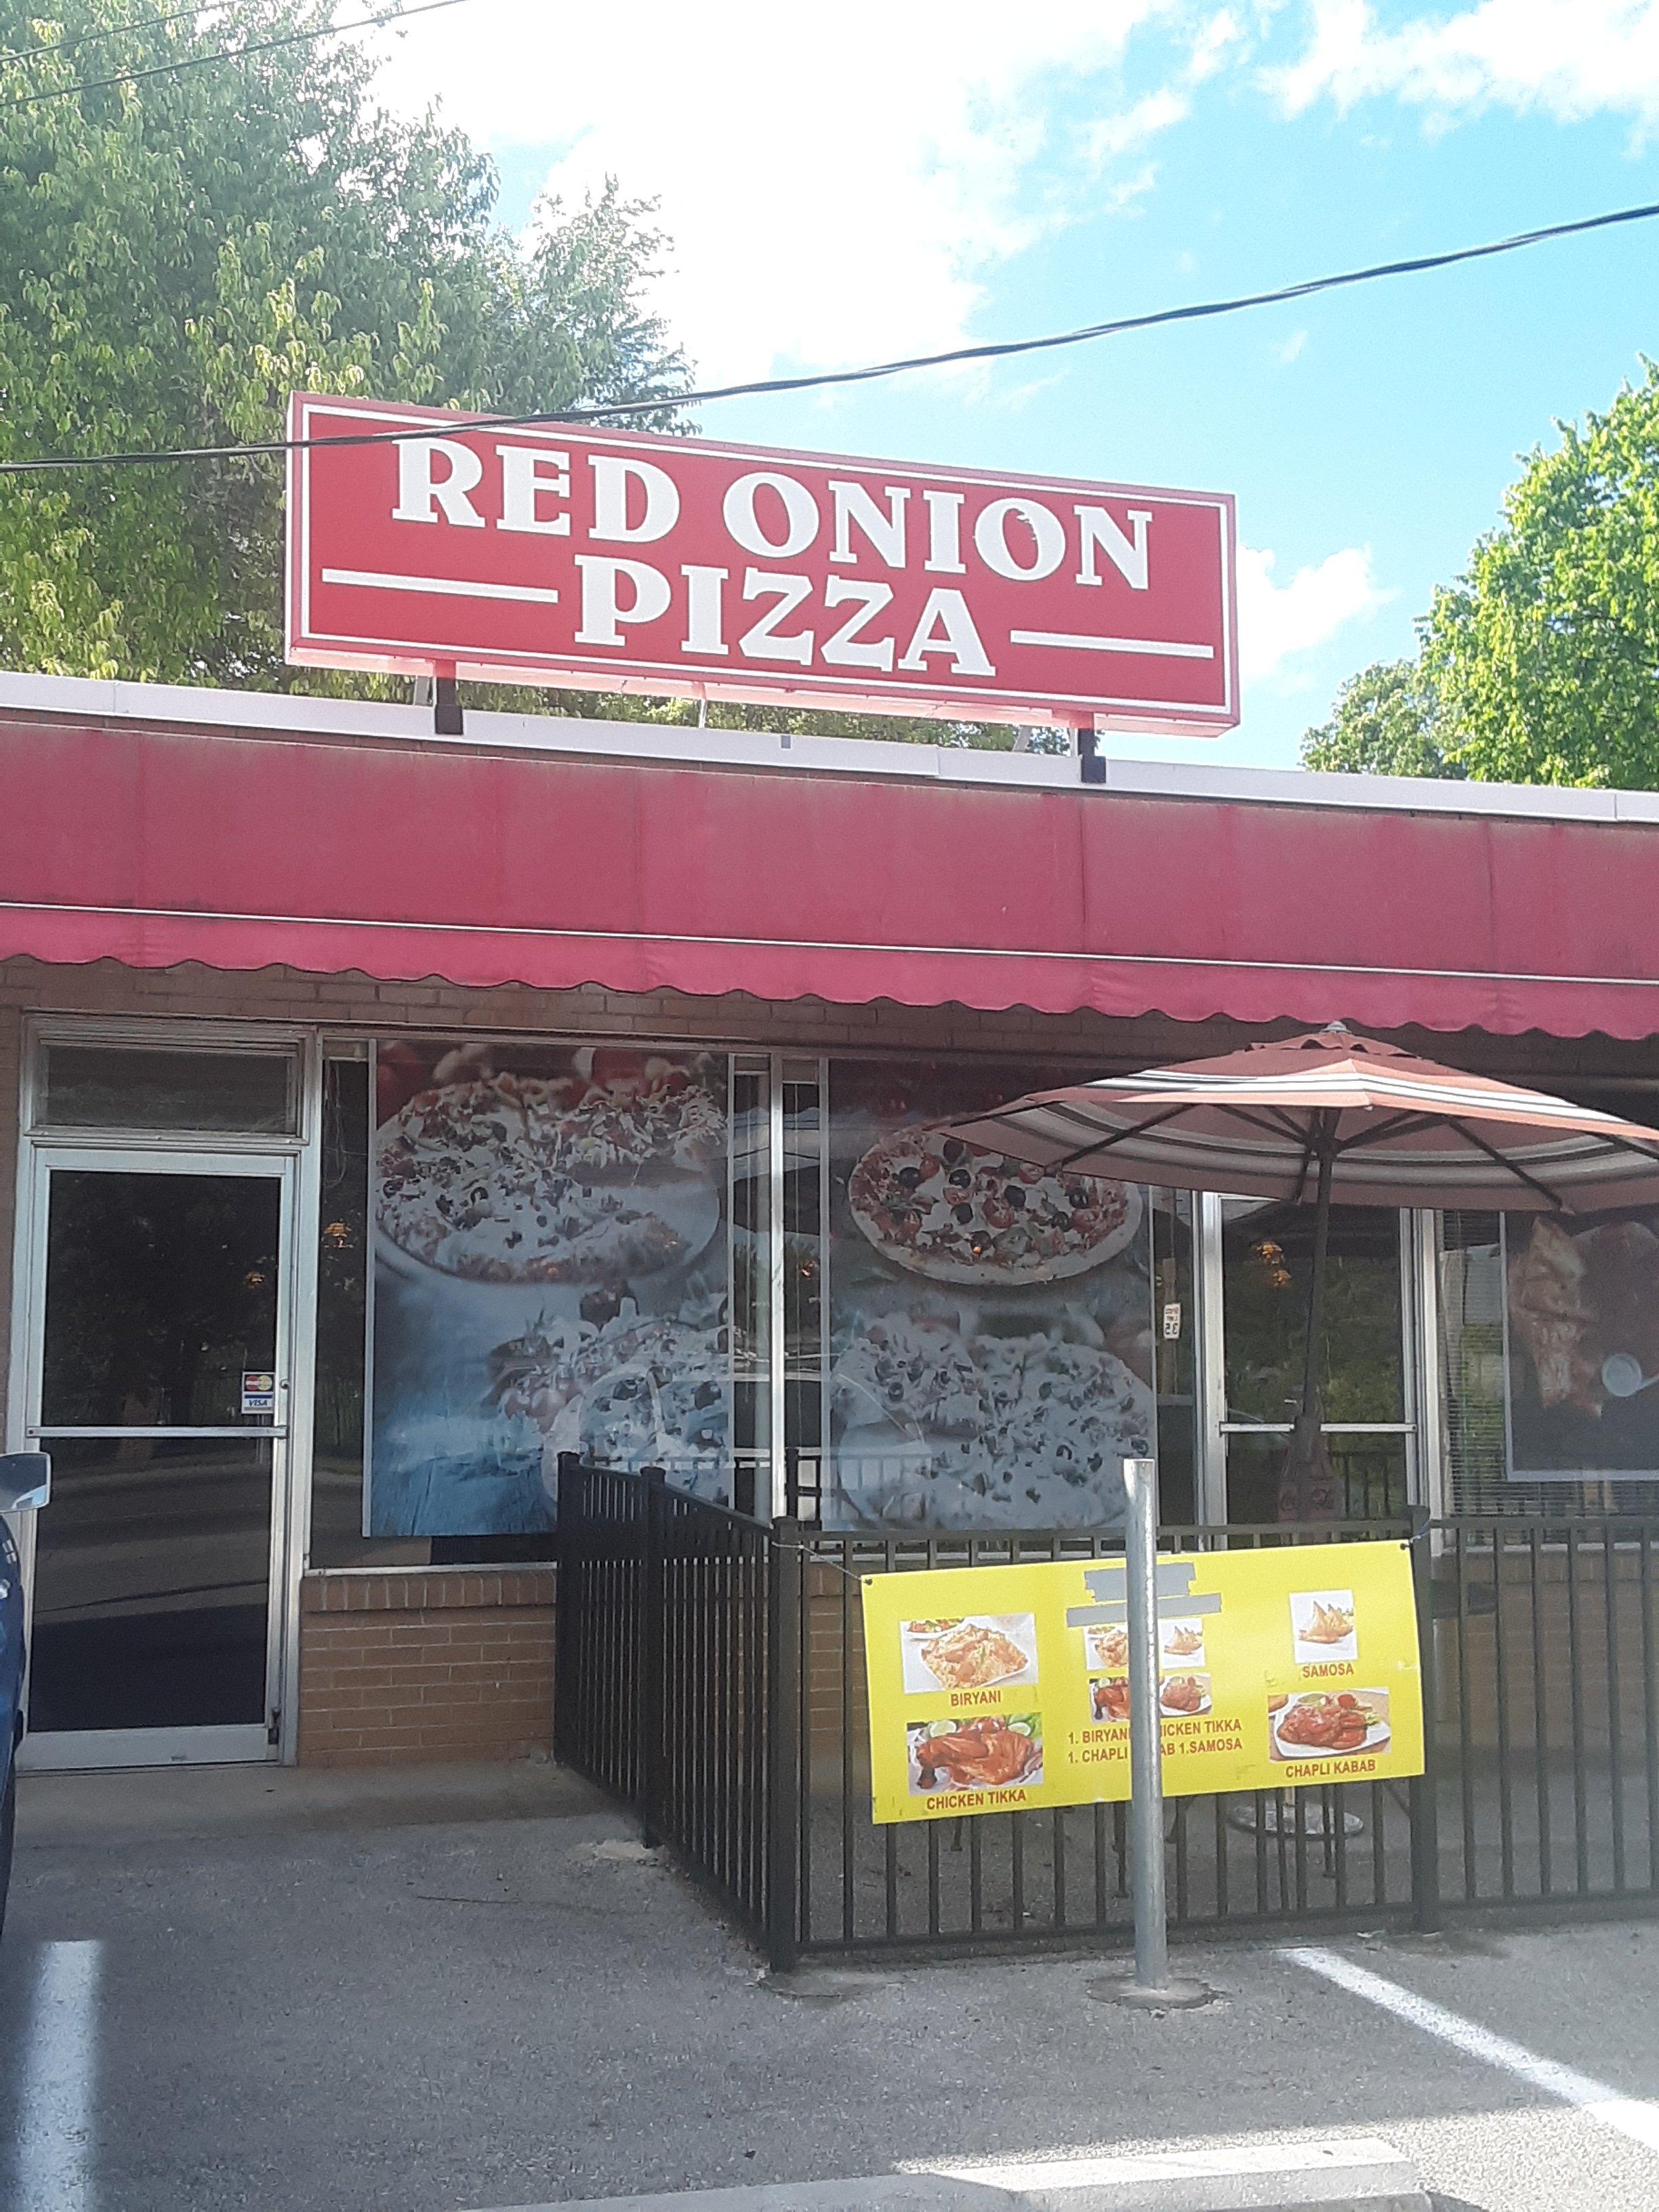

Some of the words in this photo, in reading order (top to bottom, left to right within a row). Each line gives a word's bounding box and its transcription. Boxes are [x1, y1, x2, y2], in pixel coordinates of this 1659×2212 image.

[391, 437, 680, 543] RED
[722, 471, 1153, 590] ONION
[573, 554, 996, 676] PIZZA
[249, 1399, 268, 1407] VISA
[1302, 1663, 1354, 1678] SAMOSA
[950, 1690, 1001, 1707] BIRYANI
[1068, 1732, 1079, 1744] 1.
[1204, 1718, 1242, 1733] TIKKA
[1068, 1751, 1079, 1763] 1.
[1082, 1746, 1128, 1763] CHAPLI
[1286, 1762, 1330, 1778] CHAPLI
[1334, 1759, 1376, 1774] KABAB
[926, 1792, 983, 1810] CHICKEN
[987, 1788, 1026, 1804] TIKKA
